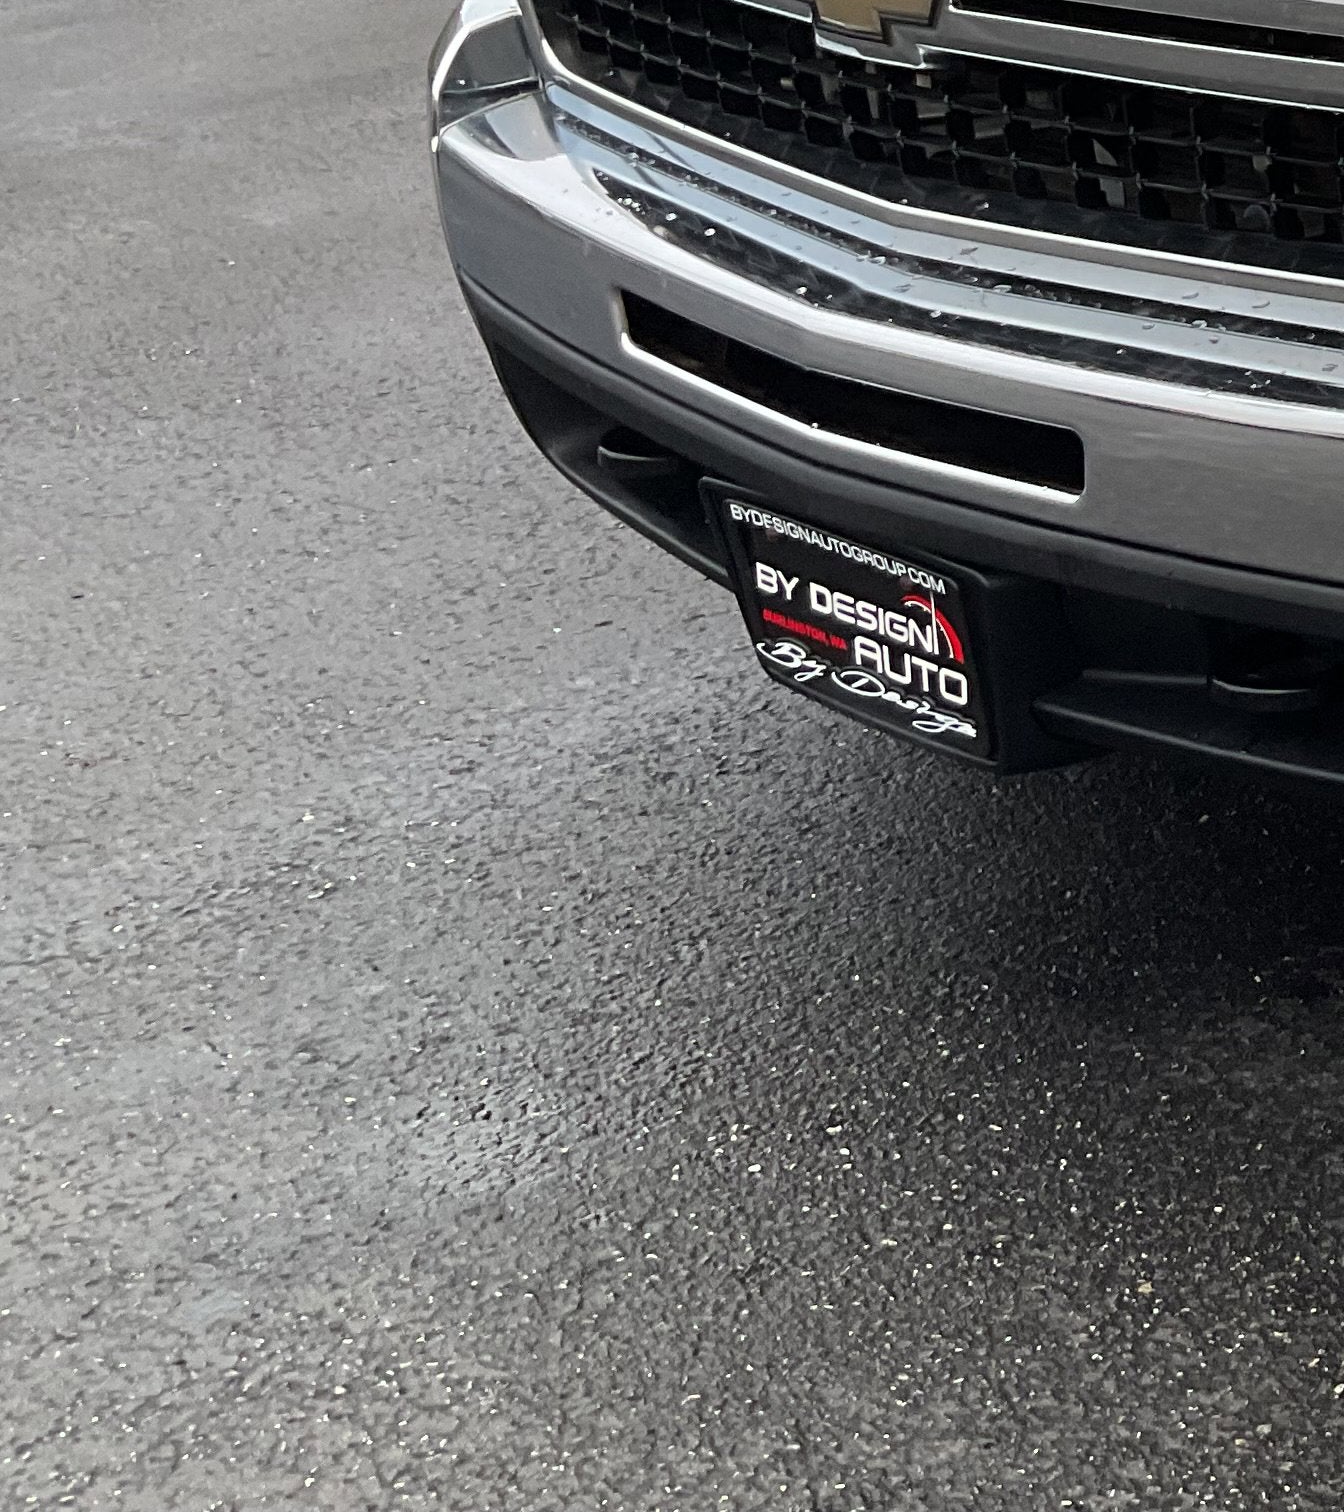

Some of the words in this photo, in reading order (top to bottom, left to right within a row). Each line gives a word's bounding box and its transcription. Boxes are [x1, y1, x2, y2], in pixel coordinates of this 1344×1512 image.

[730, 504, 946, 595] BYDESIGNAUTOGROUPCOM
[755, 562, 800, 601] BY
[809, 582, 933, 652] DESIGN
[756, 640, 825, 682] By
[853, 635, 969, 706] AUTO
